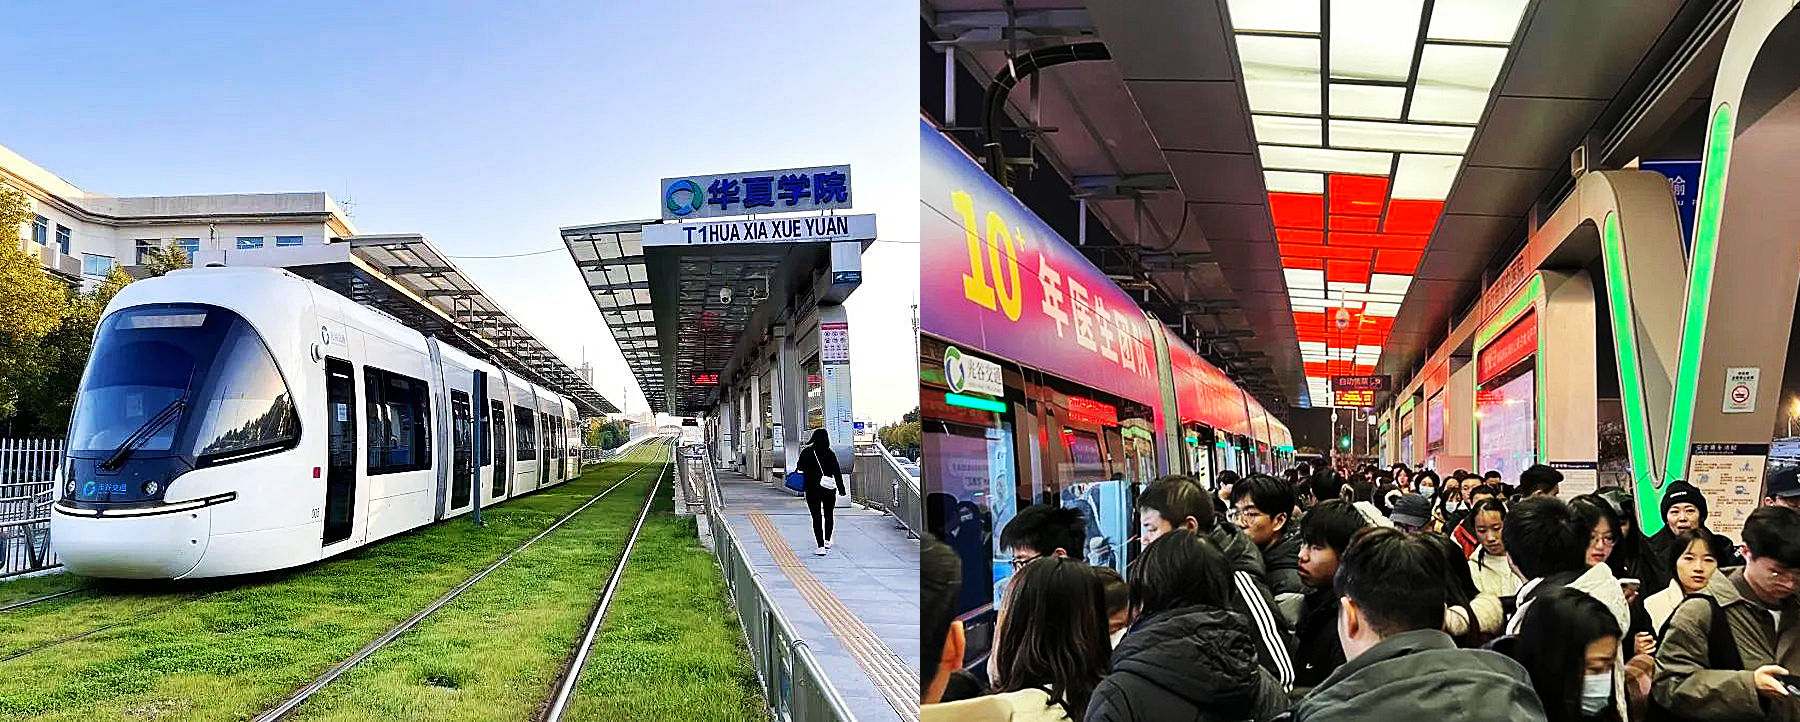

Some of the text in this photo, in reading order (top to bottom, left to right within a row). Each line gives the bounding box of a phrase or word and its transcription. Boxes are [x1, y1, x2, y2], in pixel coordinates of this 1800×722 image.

[708, 171, 849, 211] 华夏学院
[683, 216, 849, 244] T1 HUA XIA XUE YUAN
[1038, 253, 1151, 379] 年医生团队
[967, 358, 1002, 386] 光谷交通
